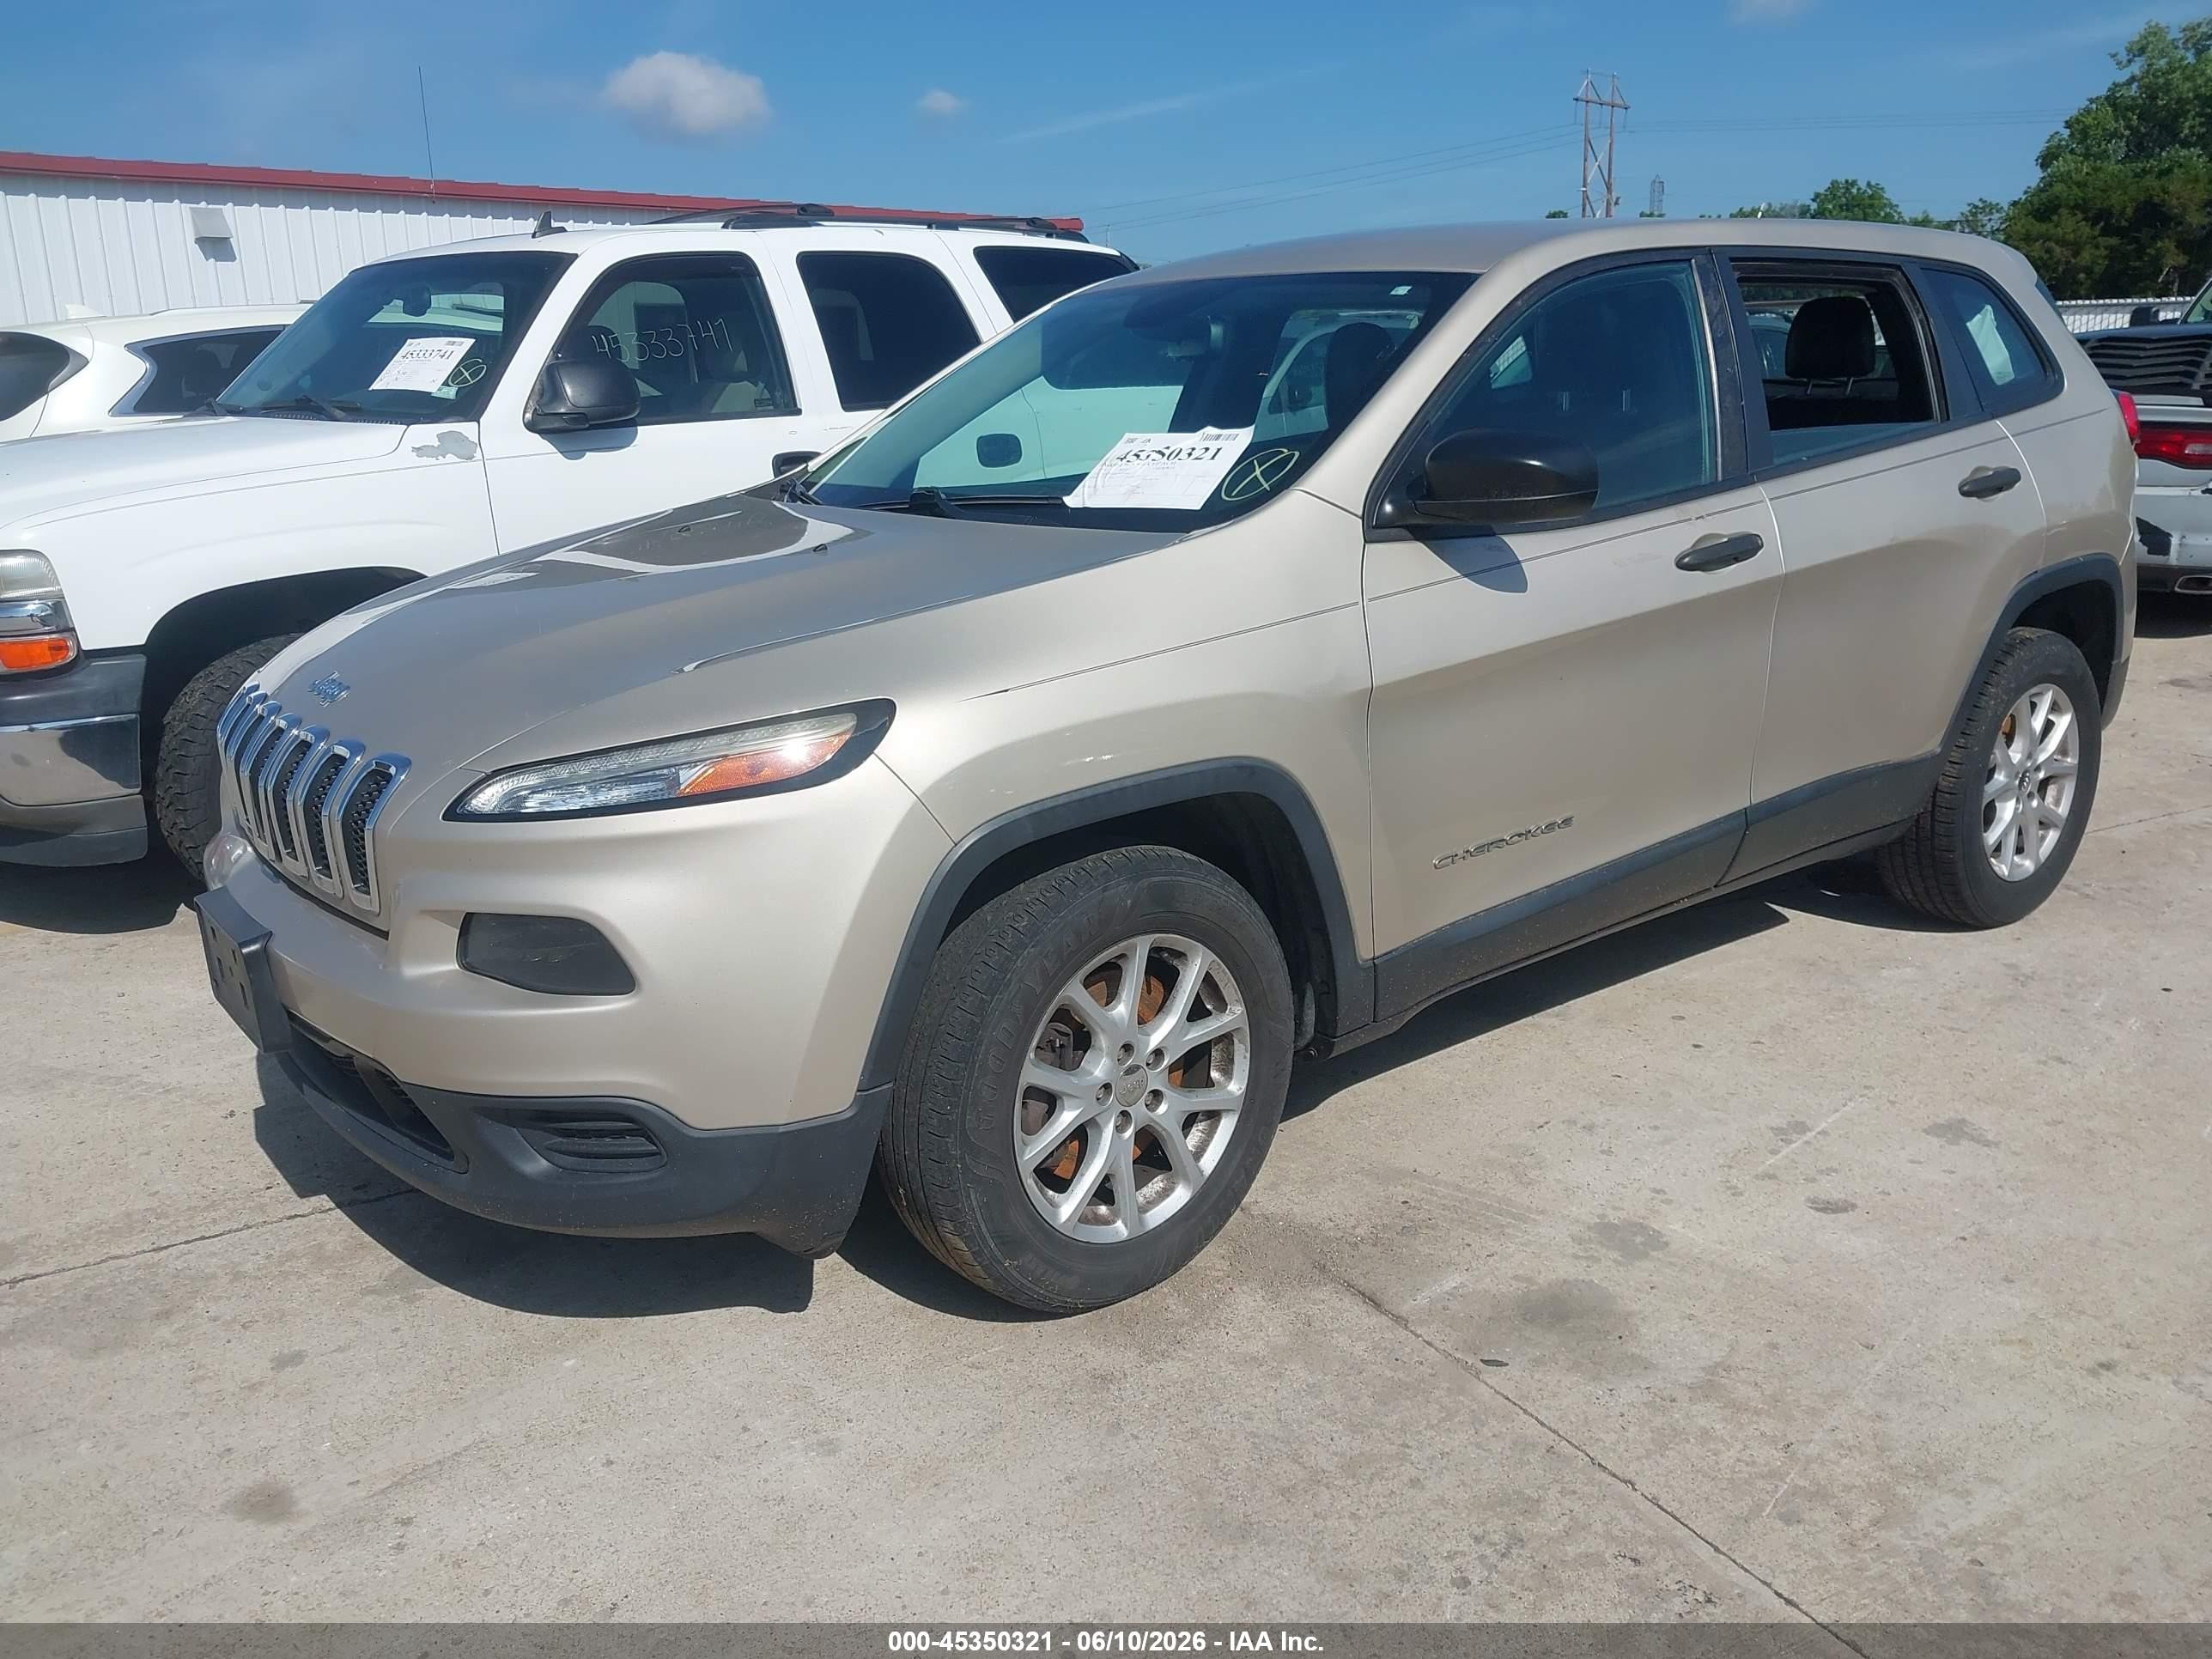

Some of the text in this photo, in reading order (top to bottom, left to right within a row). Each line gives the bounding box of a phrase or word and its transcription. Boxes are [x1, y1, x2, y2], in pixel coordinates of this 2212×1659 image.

[400, 349, 456, 360] 45333741
[591, 318, 733, 362] 45333741
[1431, 816, 1575, 870] CHEROKEE
